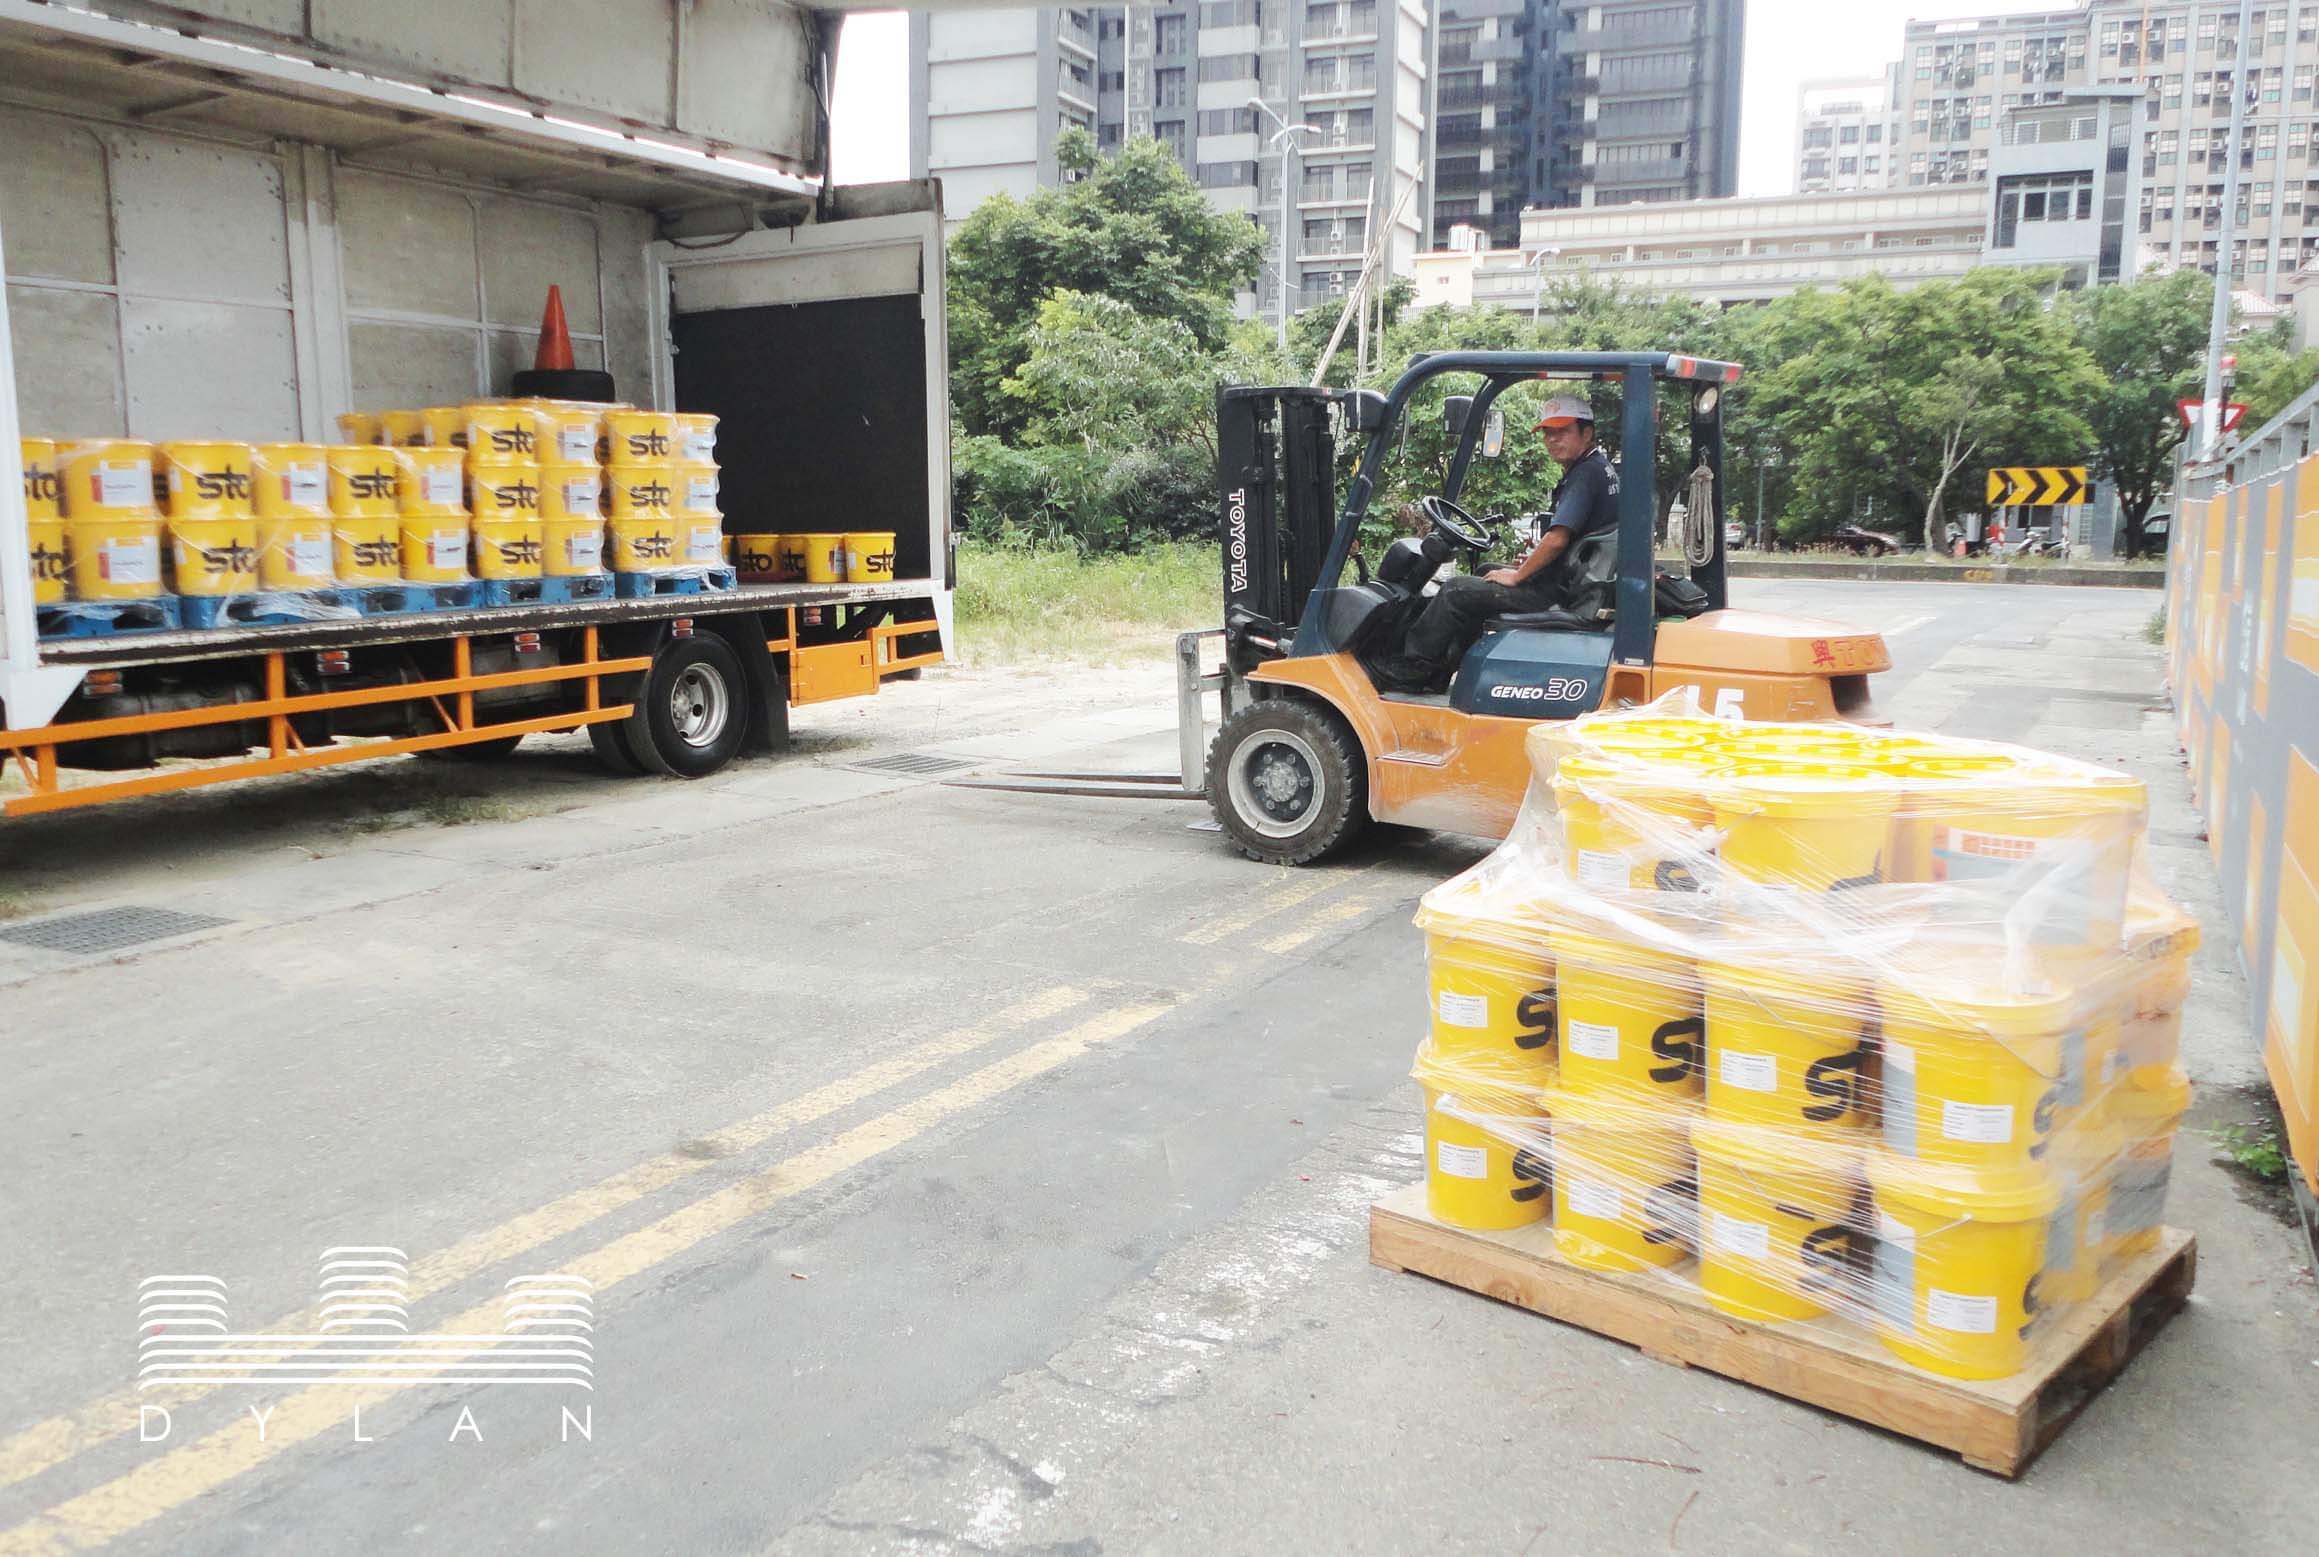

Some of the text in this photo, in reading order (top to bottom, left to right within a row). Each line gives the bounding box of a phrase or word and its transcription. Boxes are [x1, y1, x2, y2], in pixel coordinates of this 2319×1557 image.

[1228, 488, 1248, 593] TOYOTA
[1490, 677, 1588, 702] GENEO 30
